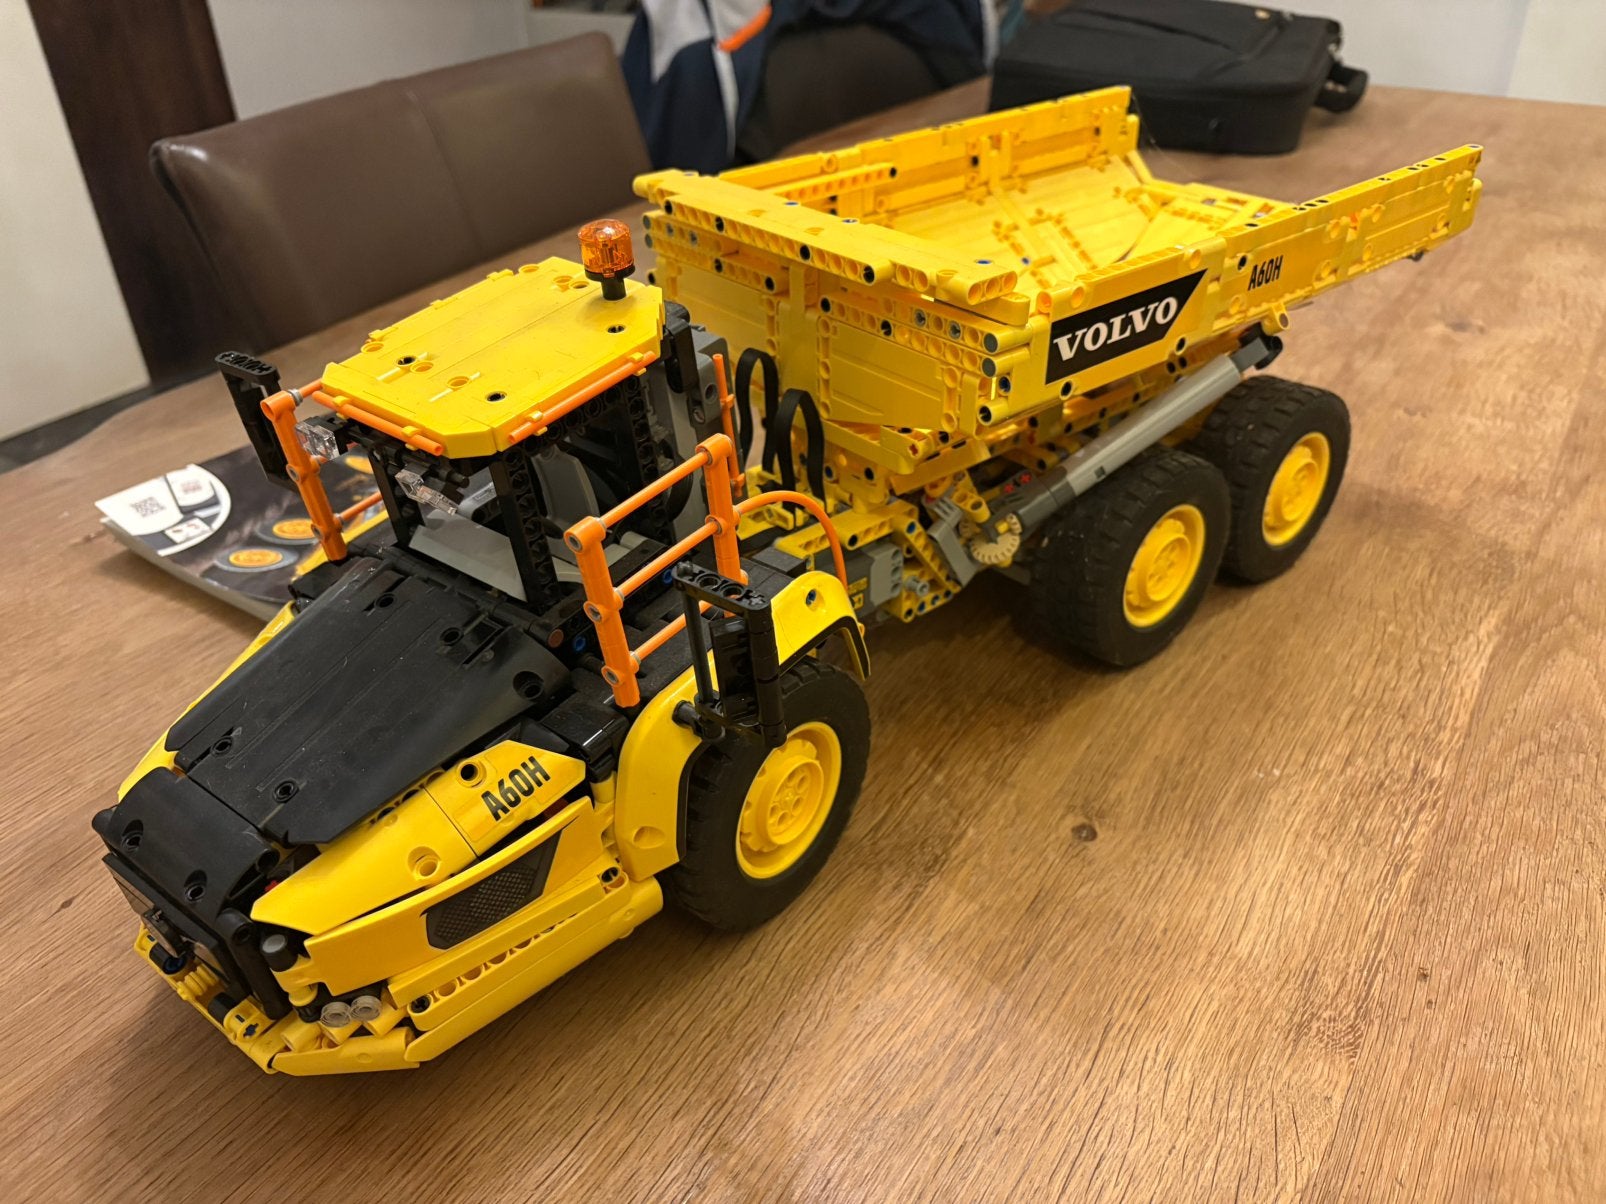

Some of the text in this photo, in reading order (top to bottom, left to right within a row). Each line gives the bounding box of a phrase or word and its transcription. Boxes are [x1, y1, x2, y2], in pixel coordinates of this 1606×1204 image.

[1247, 254, 1283, 291] A60H
[1053, 296, 1178, 361] VOLVO
[481, 755, 551, 821] A60H
